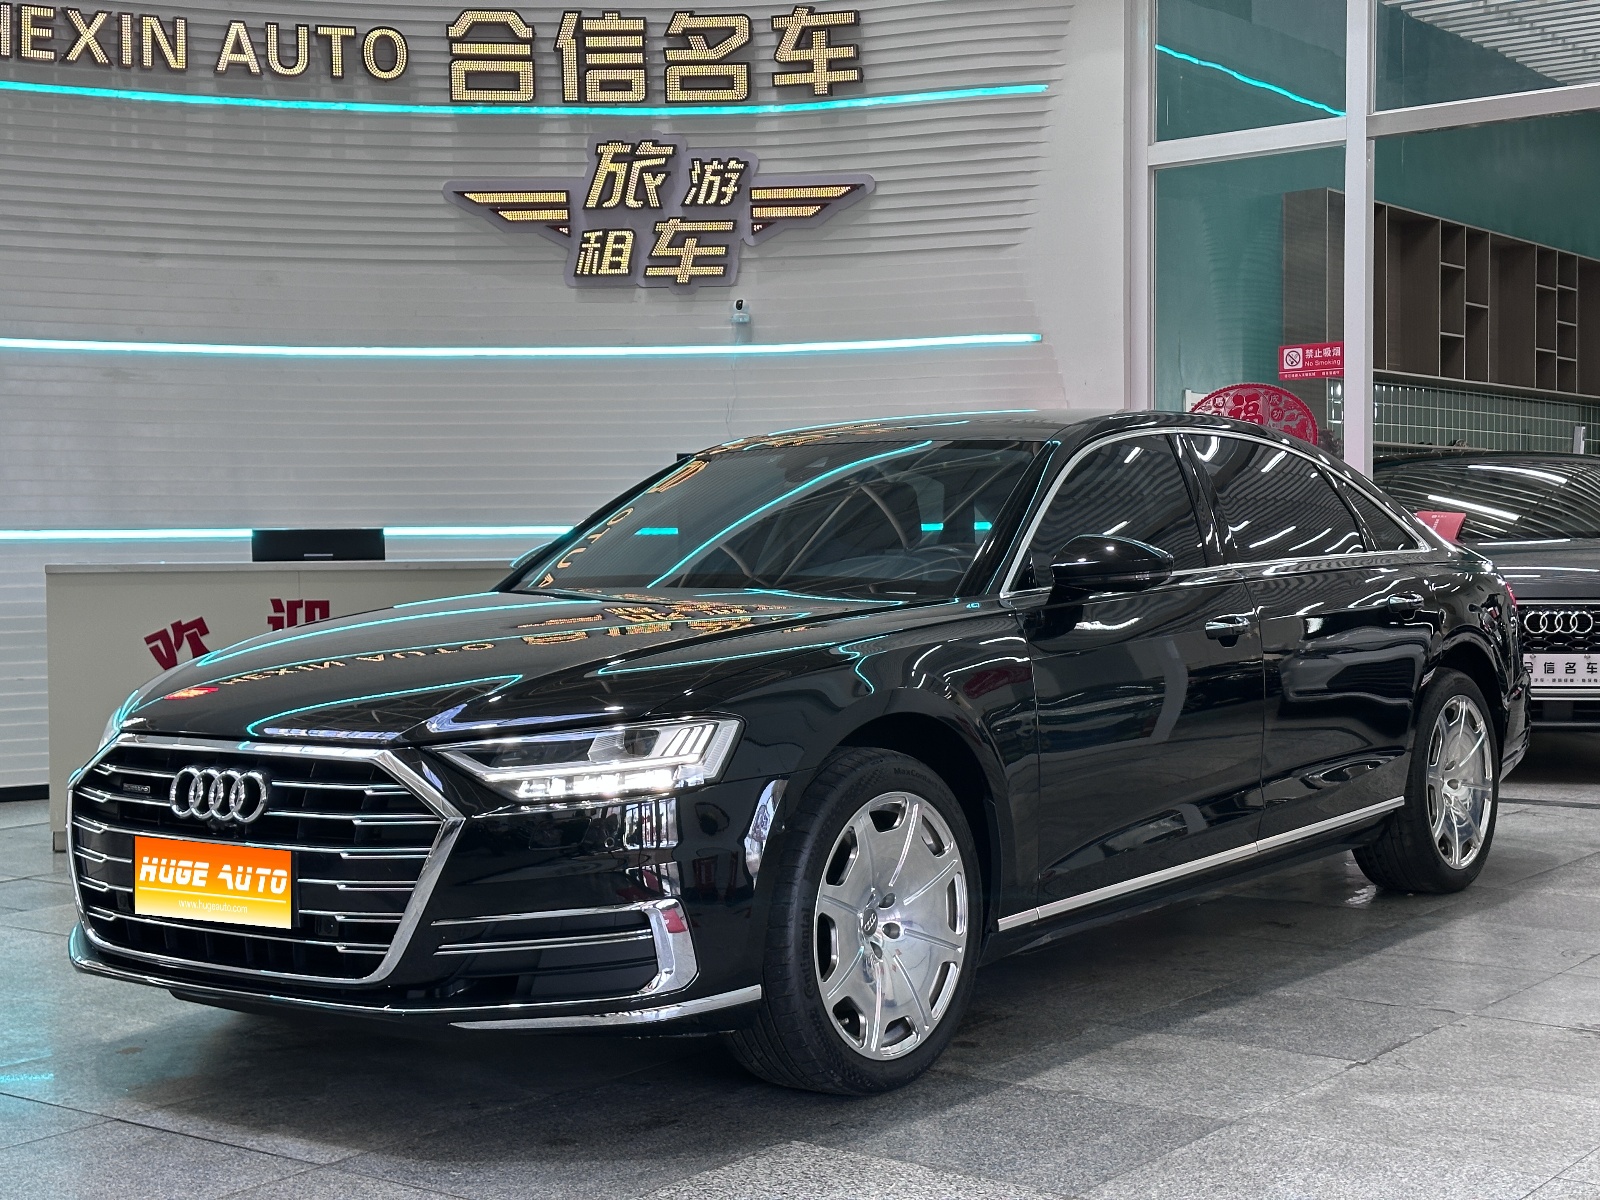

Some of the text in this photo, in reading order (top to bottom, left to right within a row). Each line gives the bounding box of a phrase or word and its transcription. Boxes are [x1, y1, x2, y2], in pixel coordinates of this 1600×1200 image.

[0, 2, 409, 81] EXIN AUTO
[446, 5, 864, 103] 合信名车
[582, 139, 750, 210] 旅游
[573, 216, 736, 285] 租车
[1305, 347, 1341, 359] 禁止吸烟
